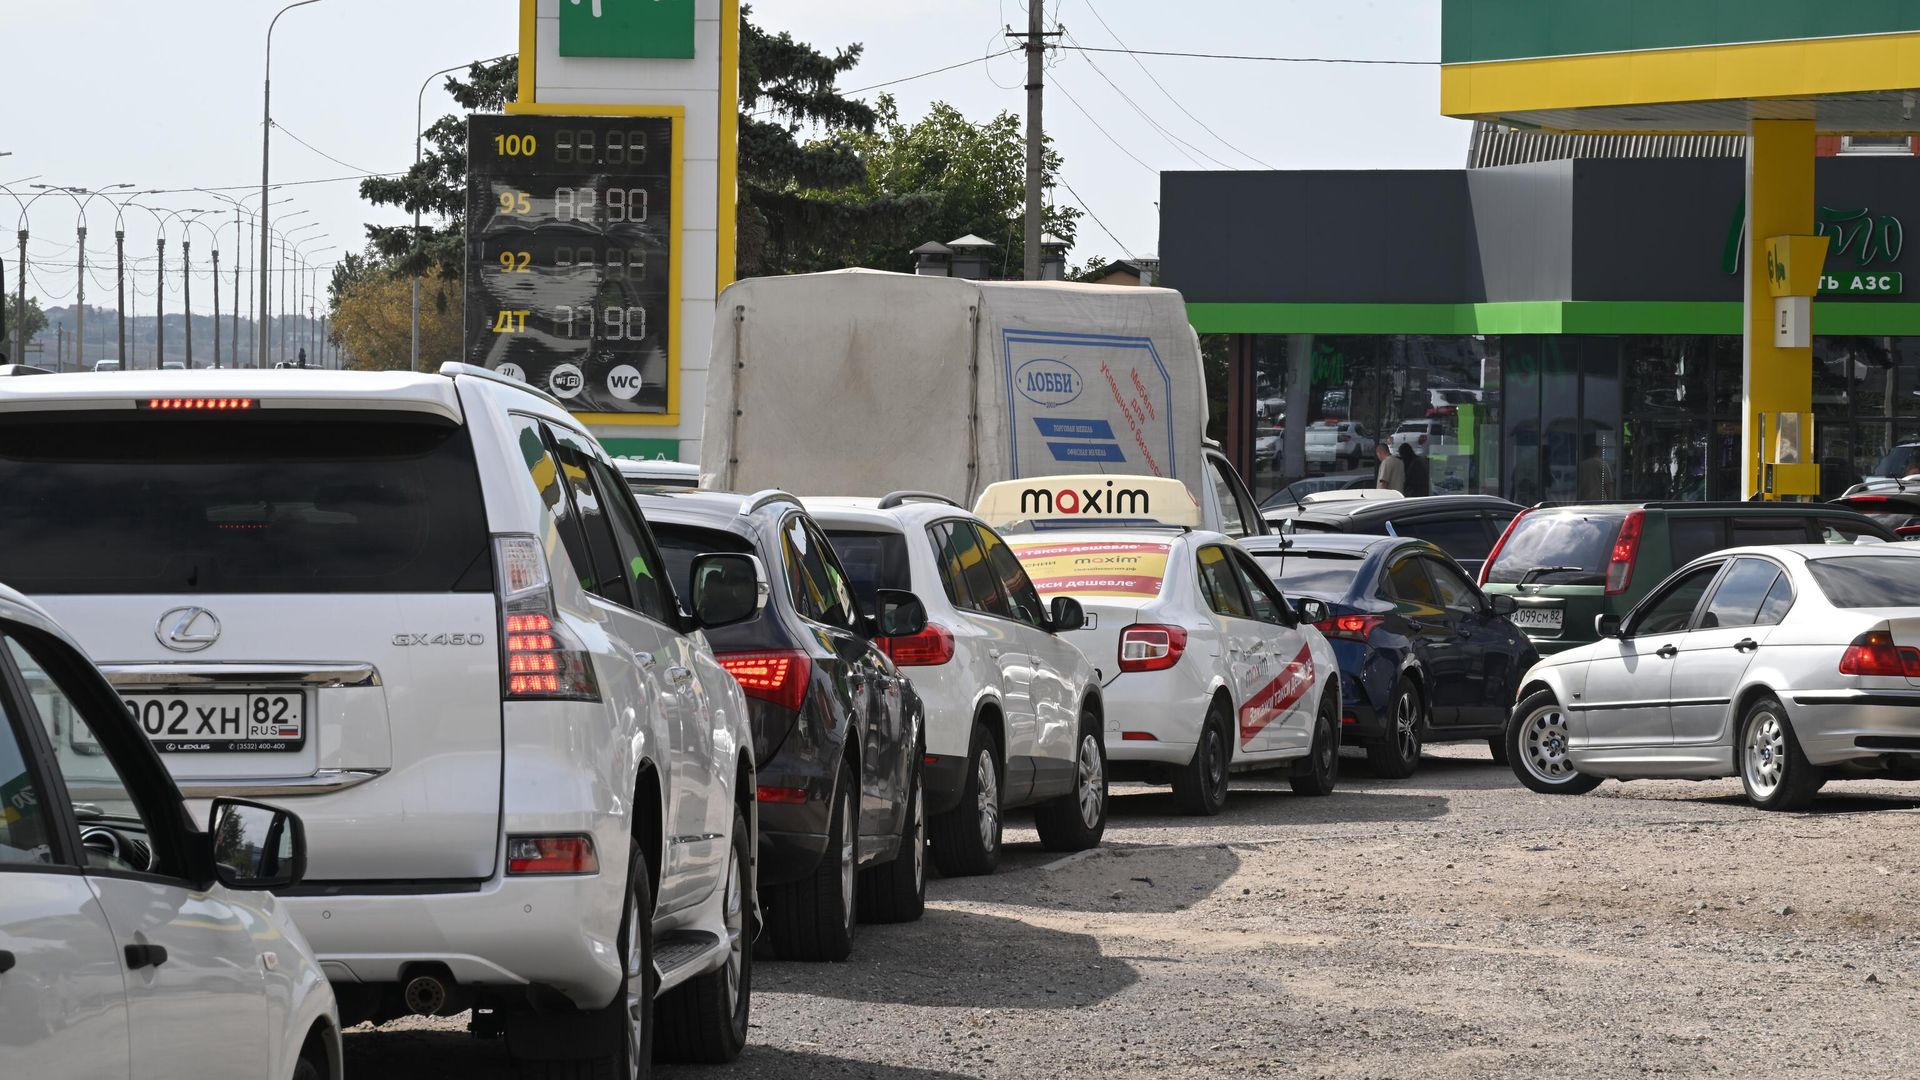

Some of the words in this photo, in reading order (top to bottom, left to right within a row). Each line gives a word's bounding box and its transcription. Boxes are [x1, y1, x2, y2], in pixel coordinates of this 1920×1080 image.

[494, 135, 536, 156] 100
[500, 193, 531, 214] 95
[555, 187, 647, 222] 82.90
[500, 251, 531, 273] 92
[1818, 276, 1839, 290] ТЬ
[1850, 276, 1891, 290] АЗС
[493, 311, 531, 333] ДТ
[556, 305, 646, 341] 77.90
[611, 376, 639, 388] WC
[1027, 371, 1073, 393] ЛОББИ
[1136, 428, 1163, 478] бизнес
[1021, 481, 1149, 514] maxim
[1074, 555, 1138, 565] maxim
[1550, 611, 1560, 620] 82
[392, 633, 485, 646] GX460
[253, 697, 288, 724] 82
[251, 725, 278, 735] RUS
